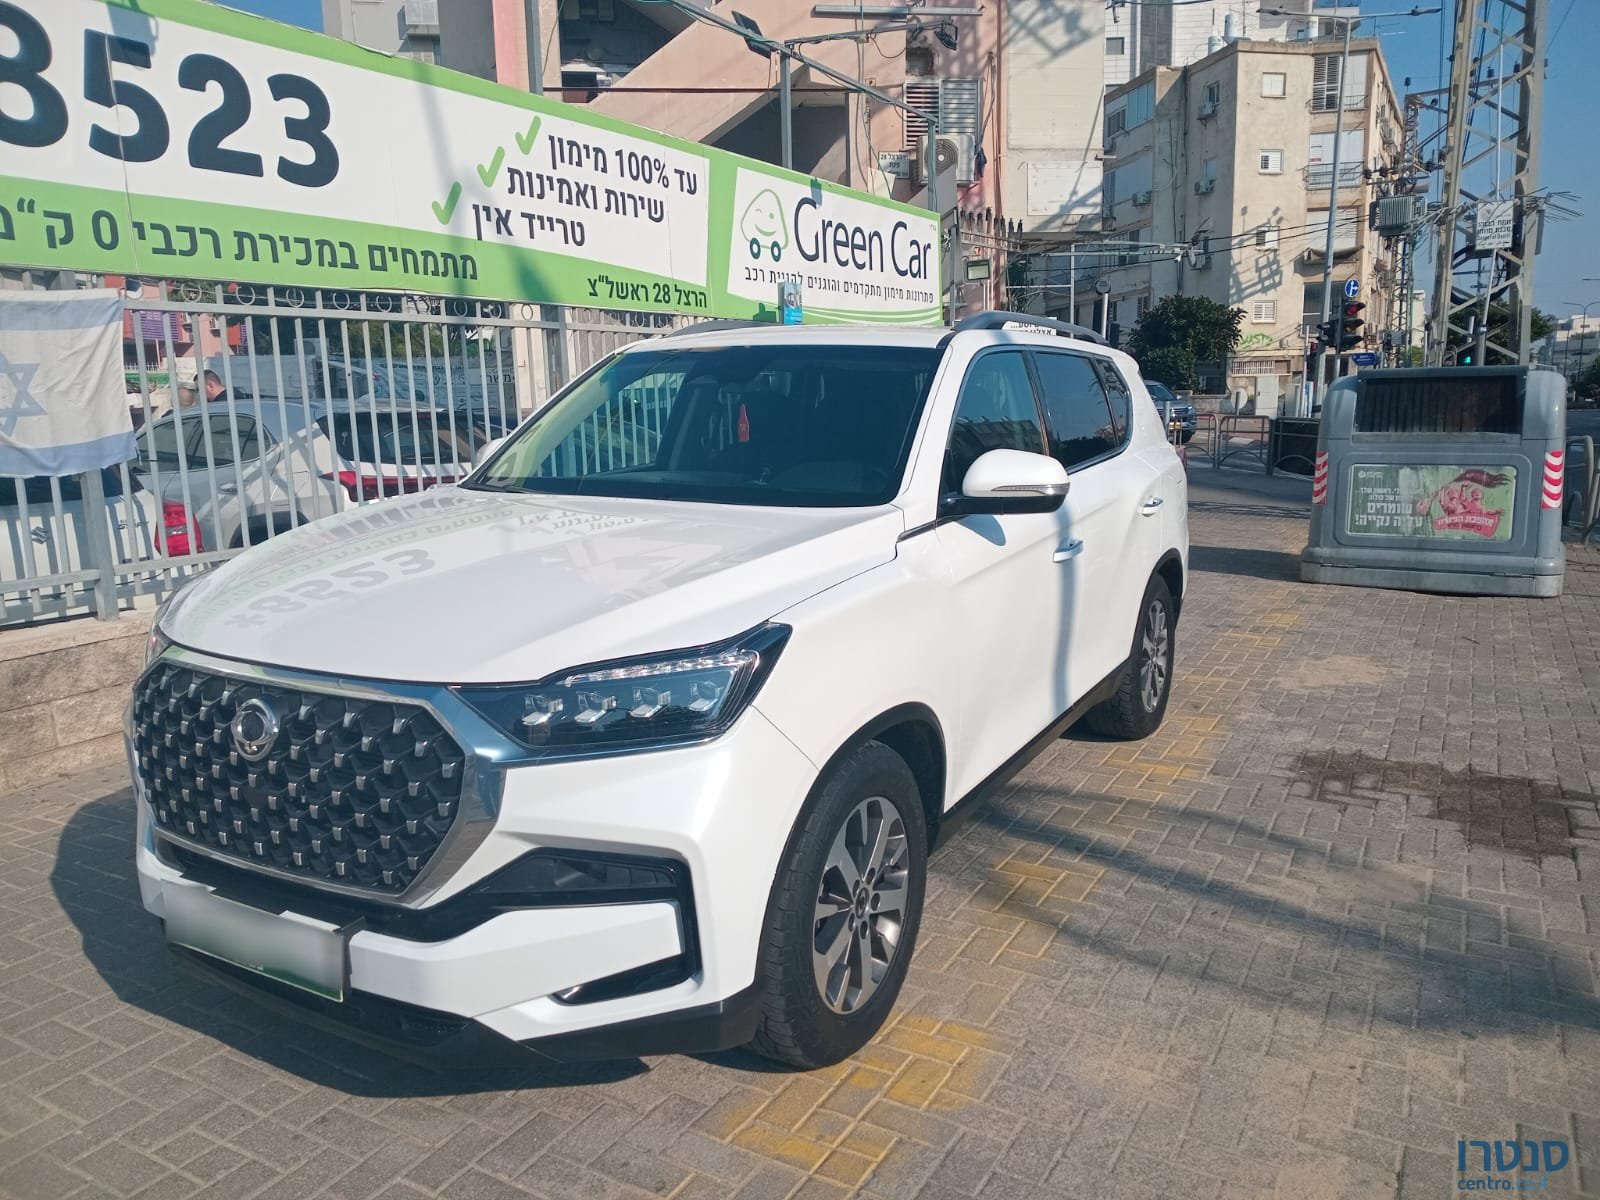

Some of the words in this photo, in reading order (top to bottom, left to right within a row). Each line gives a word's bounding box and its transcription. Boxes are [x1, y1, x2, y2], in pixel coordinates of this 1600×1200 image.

[548, 135, 608, 174] מימון
[615, 149, 670, 189] 100%
[507, 167, 598, 210] ואמינות
[674, 168, 698, 195] עד
[472, 204, 514, 241] אין
[605, 189, 664, 223] שירות
[92, 210, 119, 250] 0
[132, 220, 222, 259] רכבי
[521, 211, 585, 247] טרייד
[794, 197, 883, 273] Green
[891, 221, 931, 280] Car
[233, 230, 359, 270] במכירת
[369, 244, 478, 281] מתמחים
[745, 266, 765, 282] רכב
[807, 275, 840, 292] והוגנים
[843, 281, 881, 299] מתקדמים
[653, 282, 670, 304] 28
[674, 284, 707, 308] הרצל
[884, 286, 903, 301] מימון
[906, 289, 934, 303] פתרונות
[1393, 515, 1423, 527] עלה
